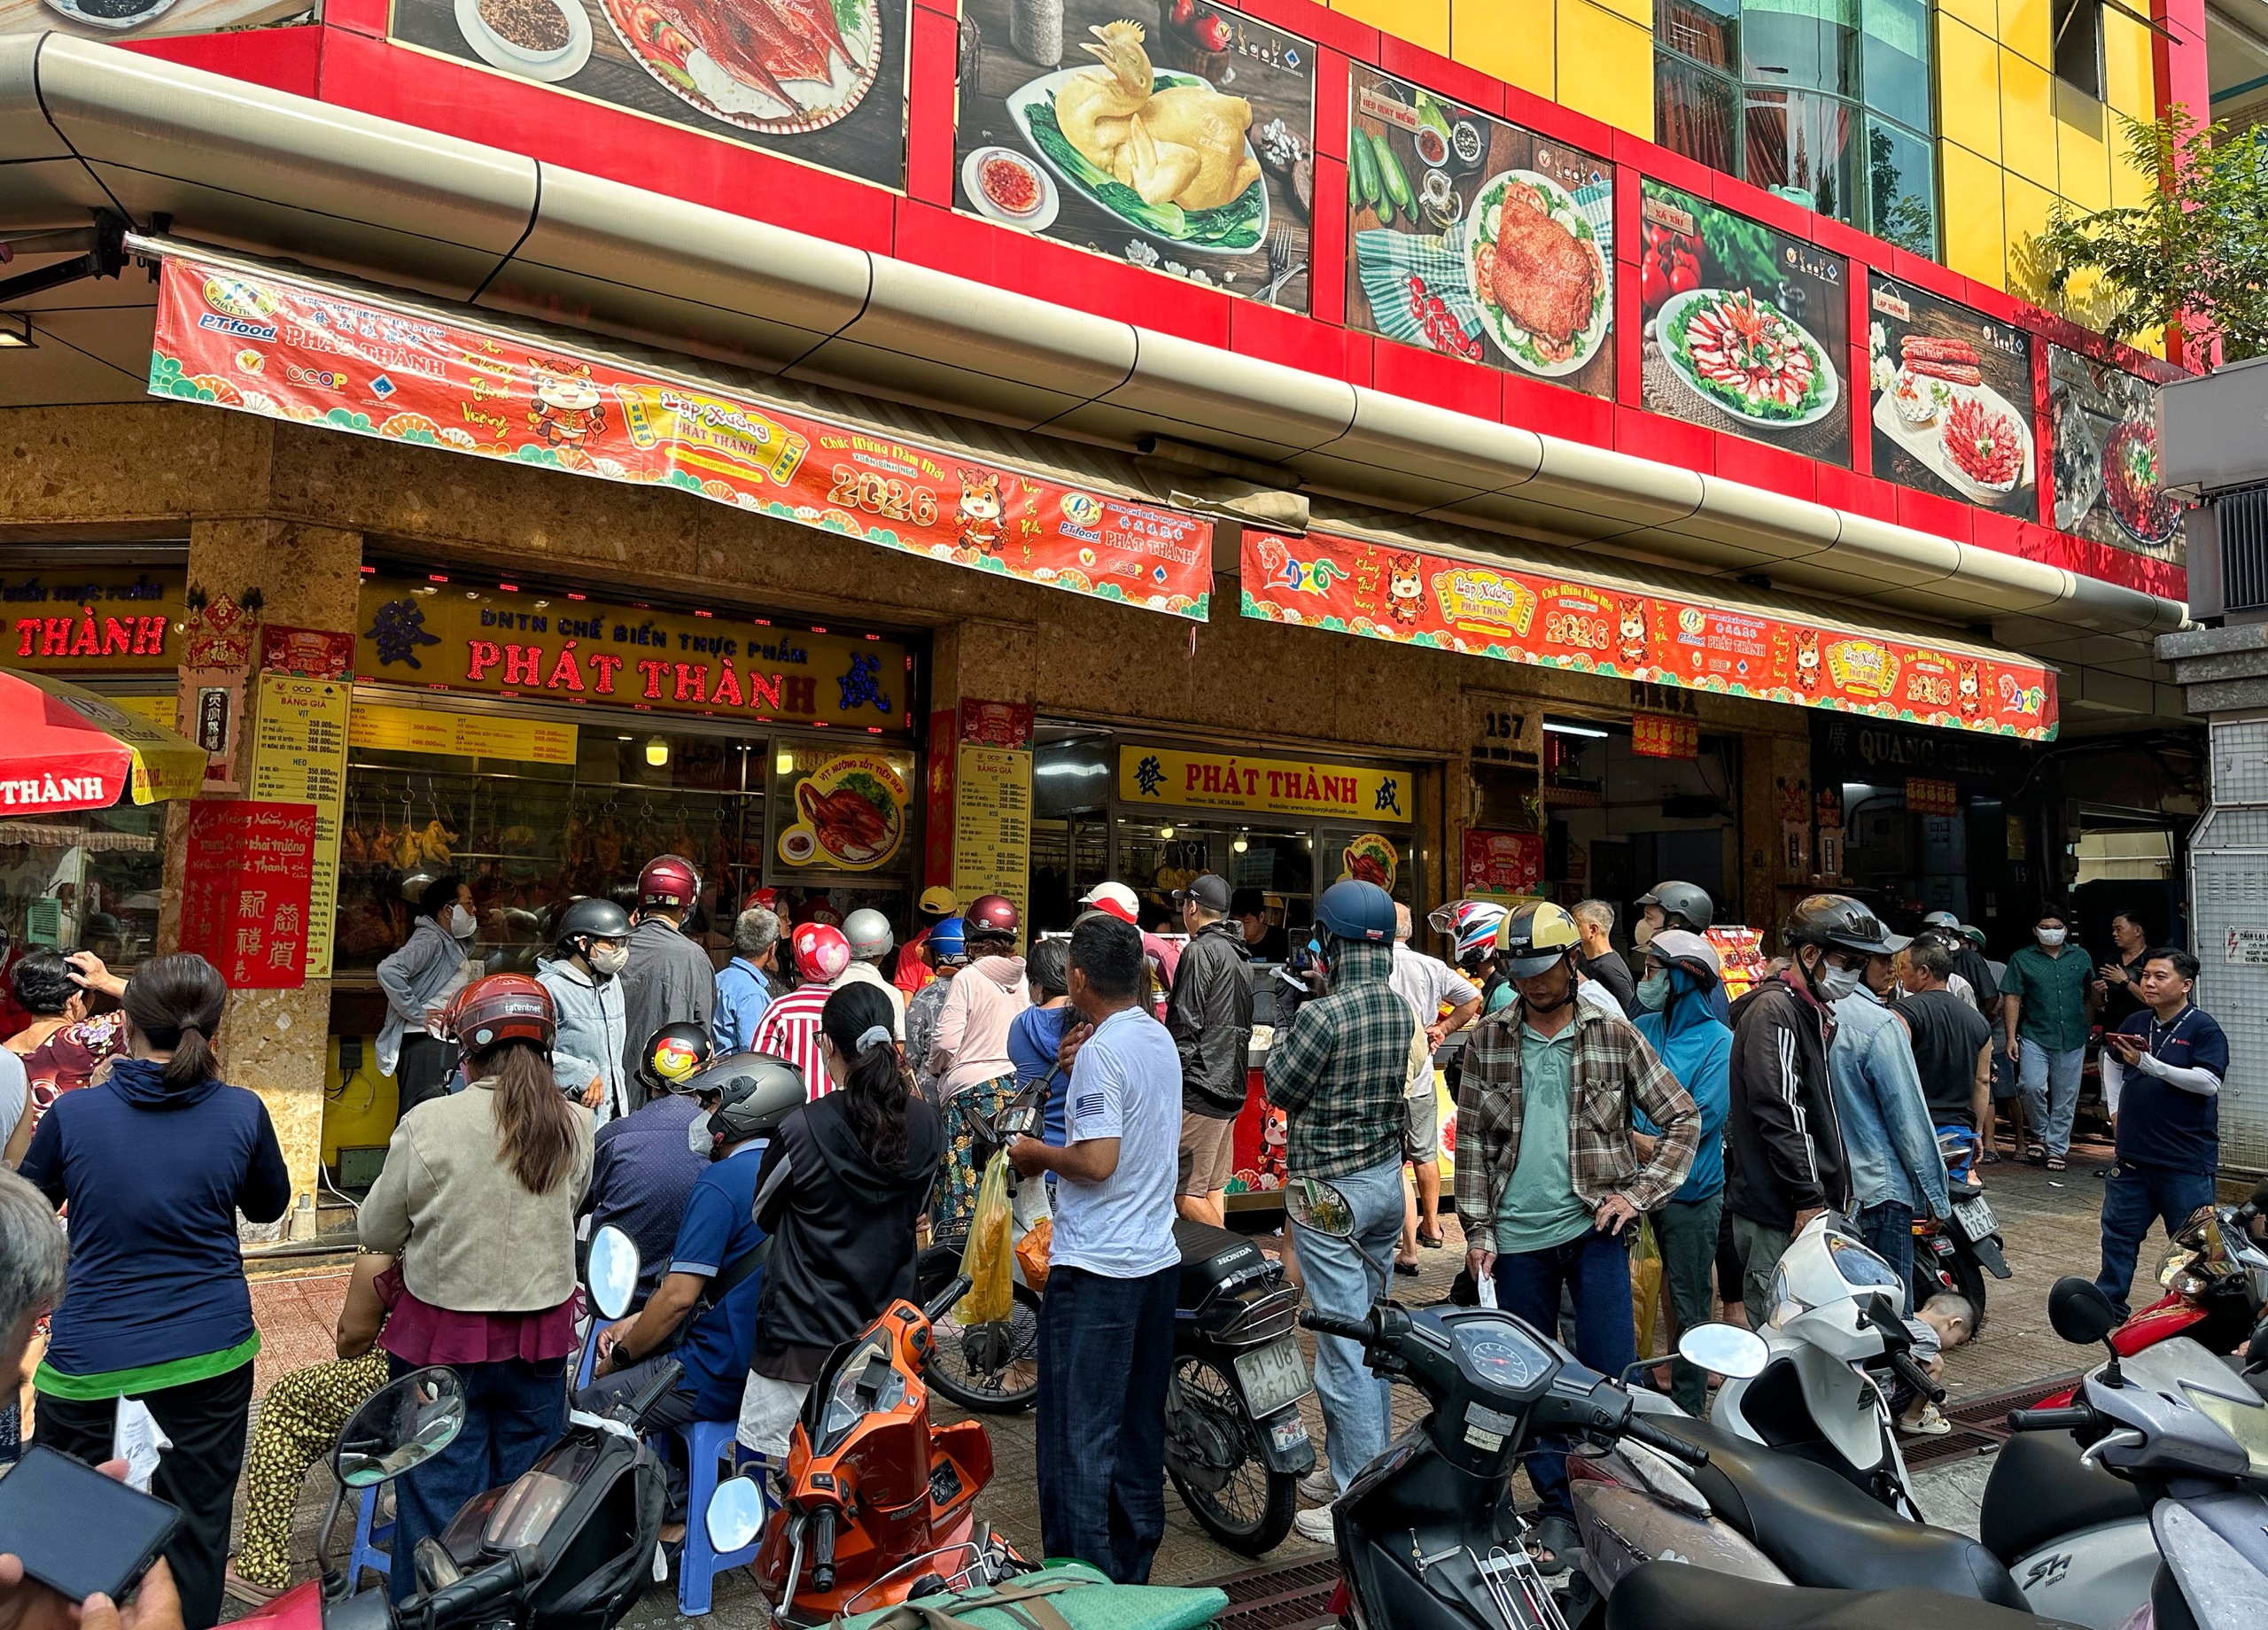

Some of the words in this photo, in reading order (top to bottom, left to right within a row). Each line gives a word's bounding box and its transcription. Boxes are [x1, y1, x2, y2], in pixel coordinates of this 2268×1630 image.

[1363, 97, 1376, 111] HEO
[1378, 104, 1394, 117] QUAY
[286, 324, 355, 357] PHÁT
[360, 342, 447, 376] THÀNH
[286, 365, 348, 388] OCOP
[660, 392, 703, 423] Lạp
[712, 432, 758, 456] THÀNH
[819, 436, 850, 452] Chúc
[851, 435, 889, 458] Mừng
[890, 445, 920, 467] Năm
[921, 459, 946, 483] Mới
[852, 453, 877, 468] XUÂN
[878, 459, 898, 472] BÍNH
[827, 463, 939, 527] 2026
[1106, 531, 1145, 553] PHÁT
[1147, 539, 1196, 565] THÀNH
[1108, 560, 1145, 577] OCOP
[1257, 537, 1350, 600] 2026
[1542, 587, 1559, 601] Chúc
[1560, 584, 1581, 599] Mừng
[1583, 587, 1599, 602] Năm
[1599, 597, 1615, 614] Mới
[15, 607, 167, 657] THÀNH
[364, 596, 442, 670] 發
[481, 609, 548, 634] DNTN
[558, 615, 603, 640] CHẾ
[613, 623, 668, 648] BIẾN
[679, 633, 738, 659] THỰC
[748, 638, 810, 665] PHẨM
[1546, 611, 1611, 650] 2026
[1708, 635, 1734, 652] PHÁT
[1734, 640, 1767, 657] THÀNH
[467, 640, 623, 695] PHÁT
[639, 657, 817, 715] THÀNH
[837, 651, 892, 714] 成
[1907, 673, 1953, 706] 2026
[281, 695, 308, 707] BẢNG
[310, 700, 327, 709] GIÁ
[1998, 673, 2048, 717] 2026
[298, 710, 309, 718] VỊT
[1485, 712, 1526, 740] 157
[818, 768, 833, 781] VỊT
[831, 759, 857, 774] NƯỚNG
[859, 757, 874, 771] XỐT
[875, 765, 892, 780] TIÊU
[890, 780, 905, 795] ĐEN
[977, 763, 998, 773] BẢNG
[999, 766, 1013, 775] GIÁ
[1133, 755, 1169, 798] 發
[1185, 758, 1260, 796] PHÁT
[1267, 765, 1358, 805] THÀNH
[0, 772, 105, 805] THÀNH
[1184, 796, 1208, 805] Hotline:
[1374, 776, 1402, 818] 成
[190, 806, 215, 839] Chúc
[253, 811, 286, 831] Năm
[1267, 802, 1290, 811] Website:
[1965, 1211, 1998, 1239] 126.20
[1216, 1246, 1254, 1266] HONDA
[2023, 1553, 2073, 1591] SH
